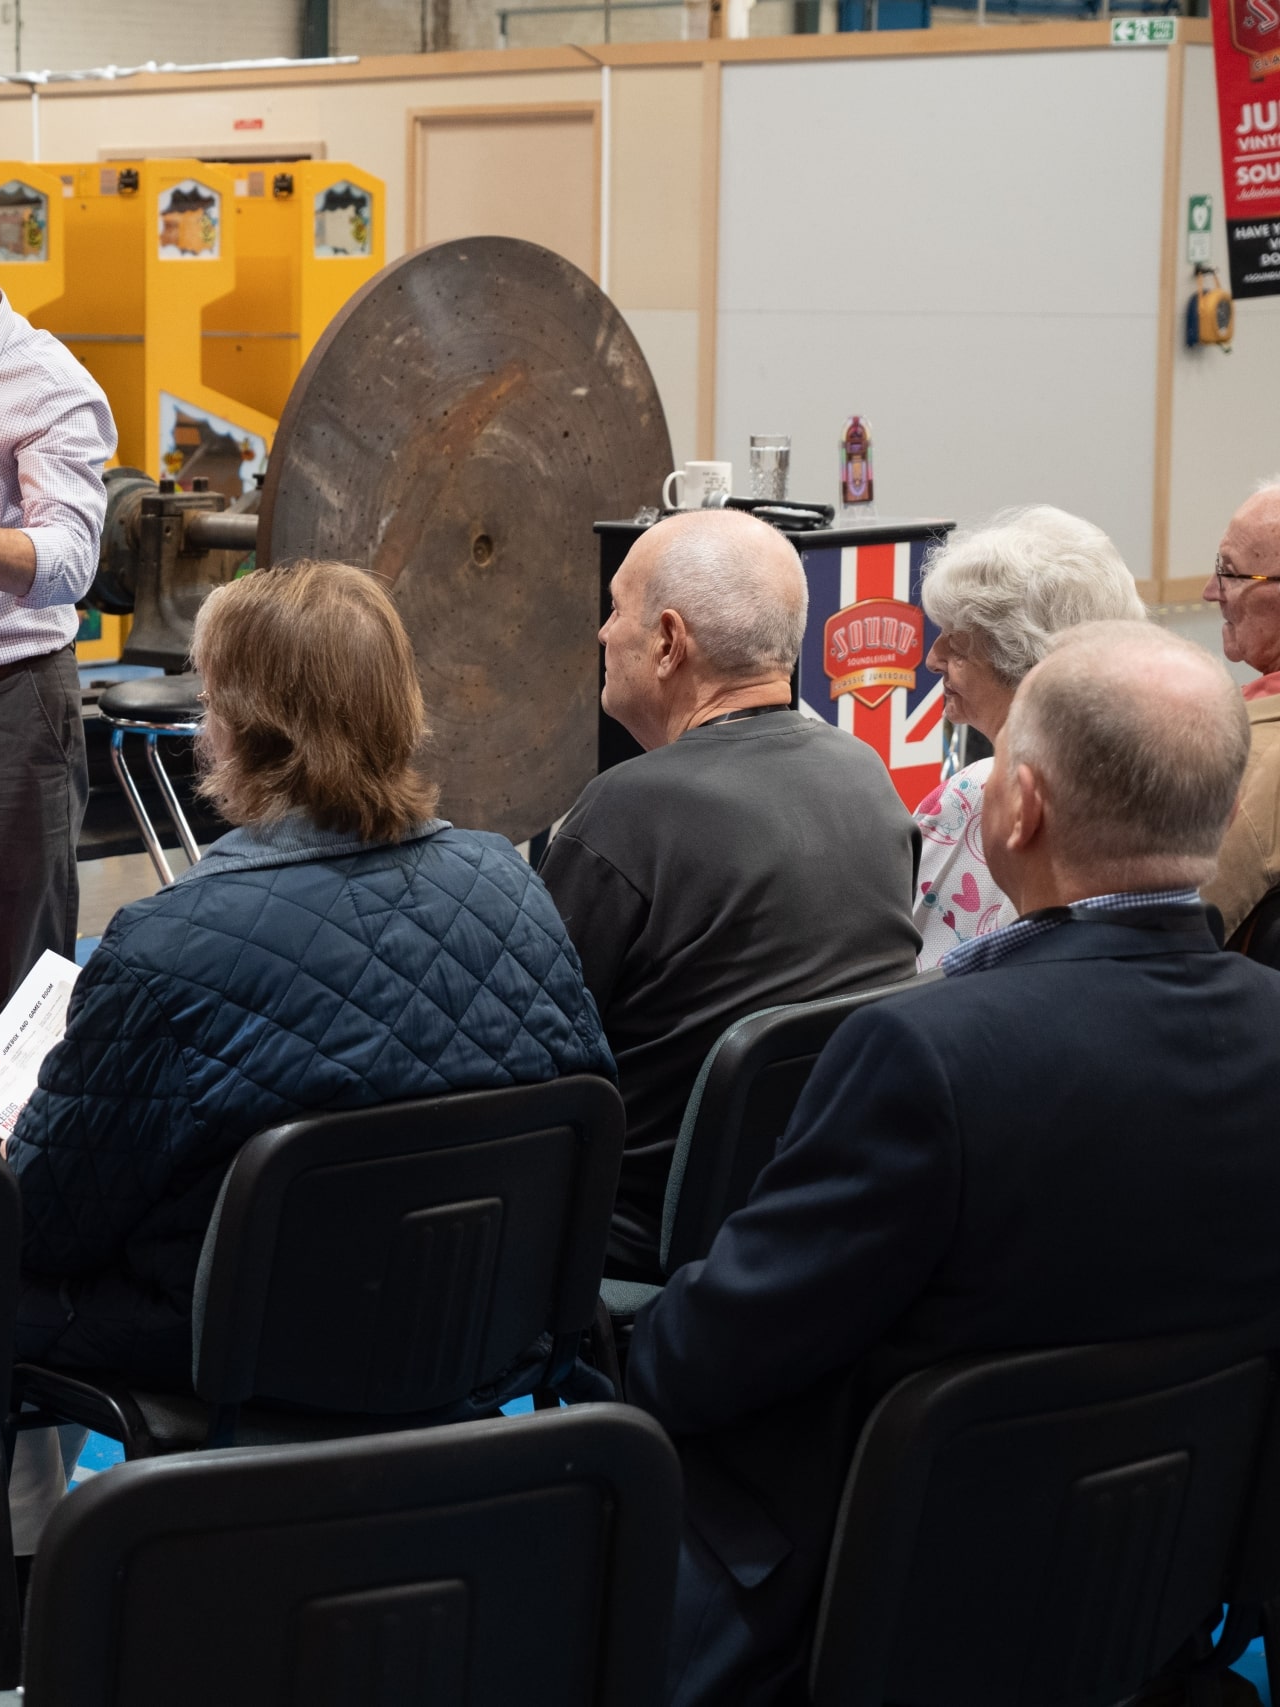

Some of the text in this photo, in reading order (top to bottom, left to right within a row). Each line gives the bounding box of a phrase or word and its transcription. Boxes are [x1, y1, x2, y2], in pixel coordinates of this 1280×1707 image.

[1235, 100, 1280, 134] JU
[1234, 223, 1270, 240] HAVE
[832, 616, 916, 662] SOUND
[846, 653, 896, 667] SOUNDLEISURE
[2, 1033, 19, 1055] JUKEBOX
[19, 1020, 29, 1032] AND
[28, 1000, 42, 1019] GAMES
[41, 983, 54, 1000] ROOM
